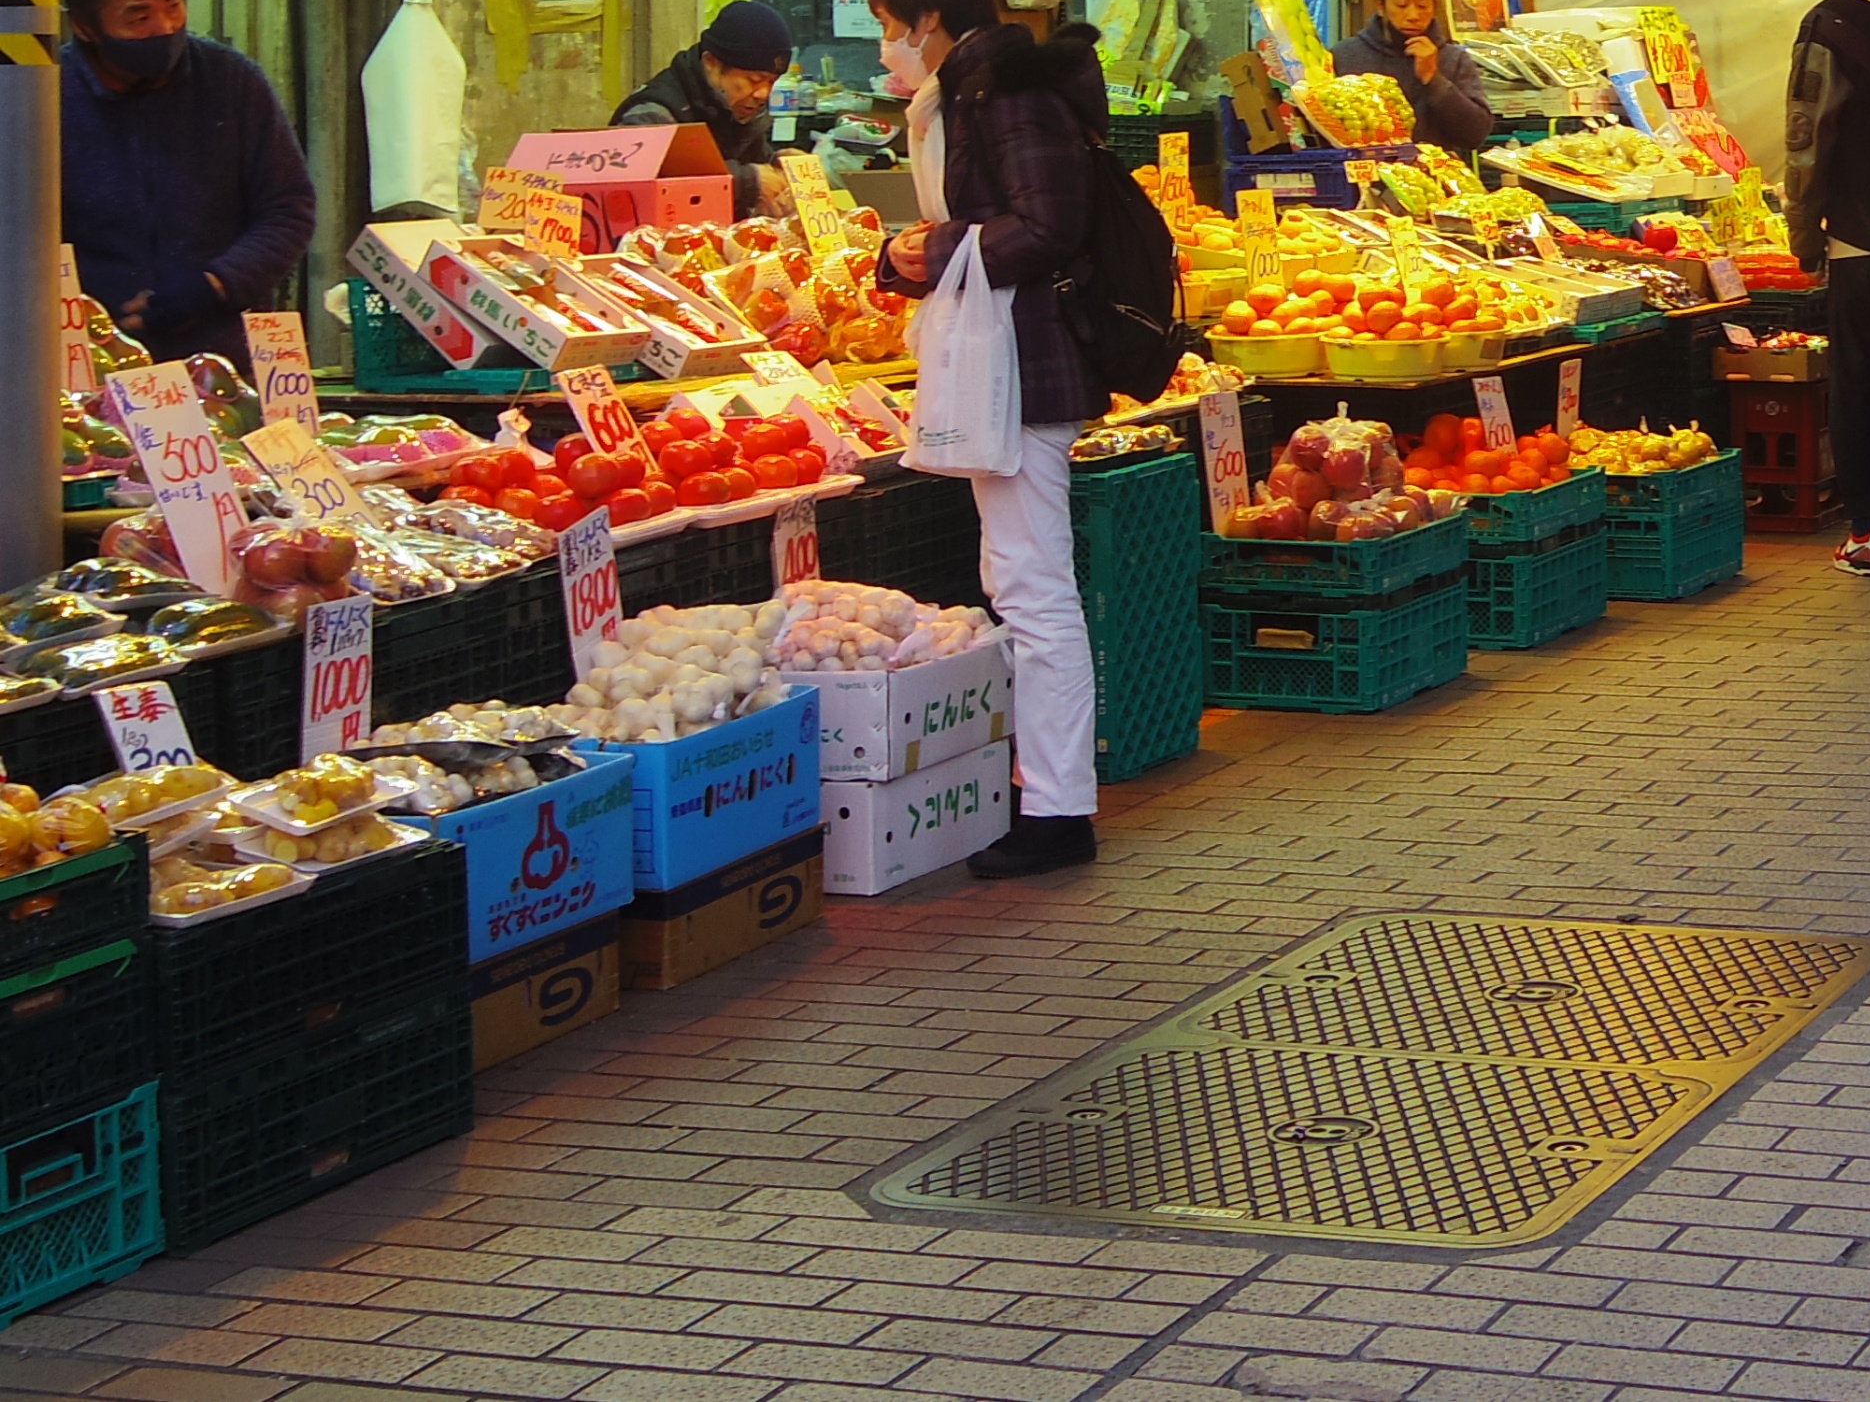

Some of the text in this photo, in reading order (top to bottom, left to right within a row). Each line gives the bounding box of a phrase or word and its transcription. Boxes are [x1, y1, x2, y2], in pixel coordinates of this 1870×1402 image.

[265, 366, 311, 404] 1000
[588, 399, 636, 452] 600
[160, 431, 219, 483] 500
[1213, 437, 1243, 483] 600
[291, 477, 346, 519] 300
[923, 679, 993, 737] にんにく
